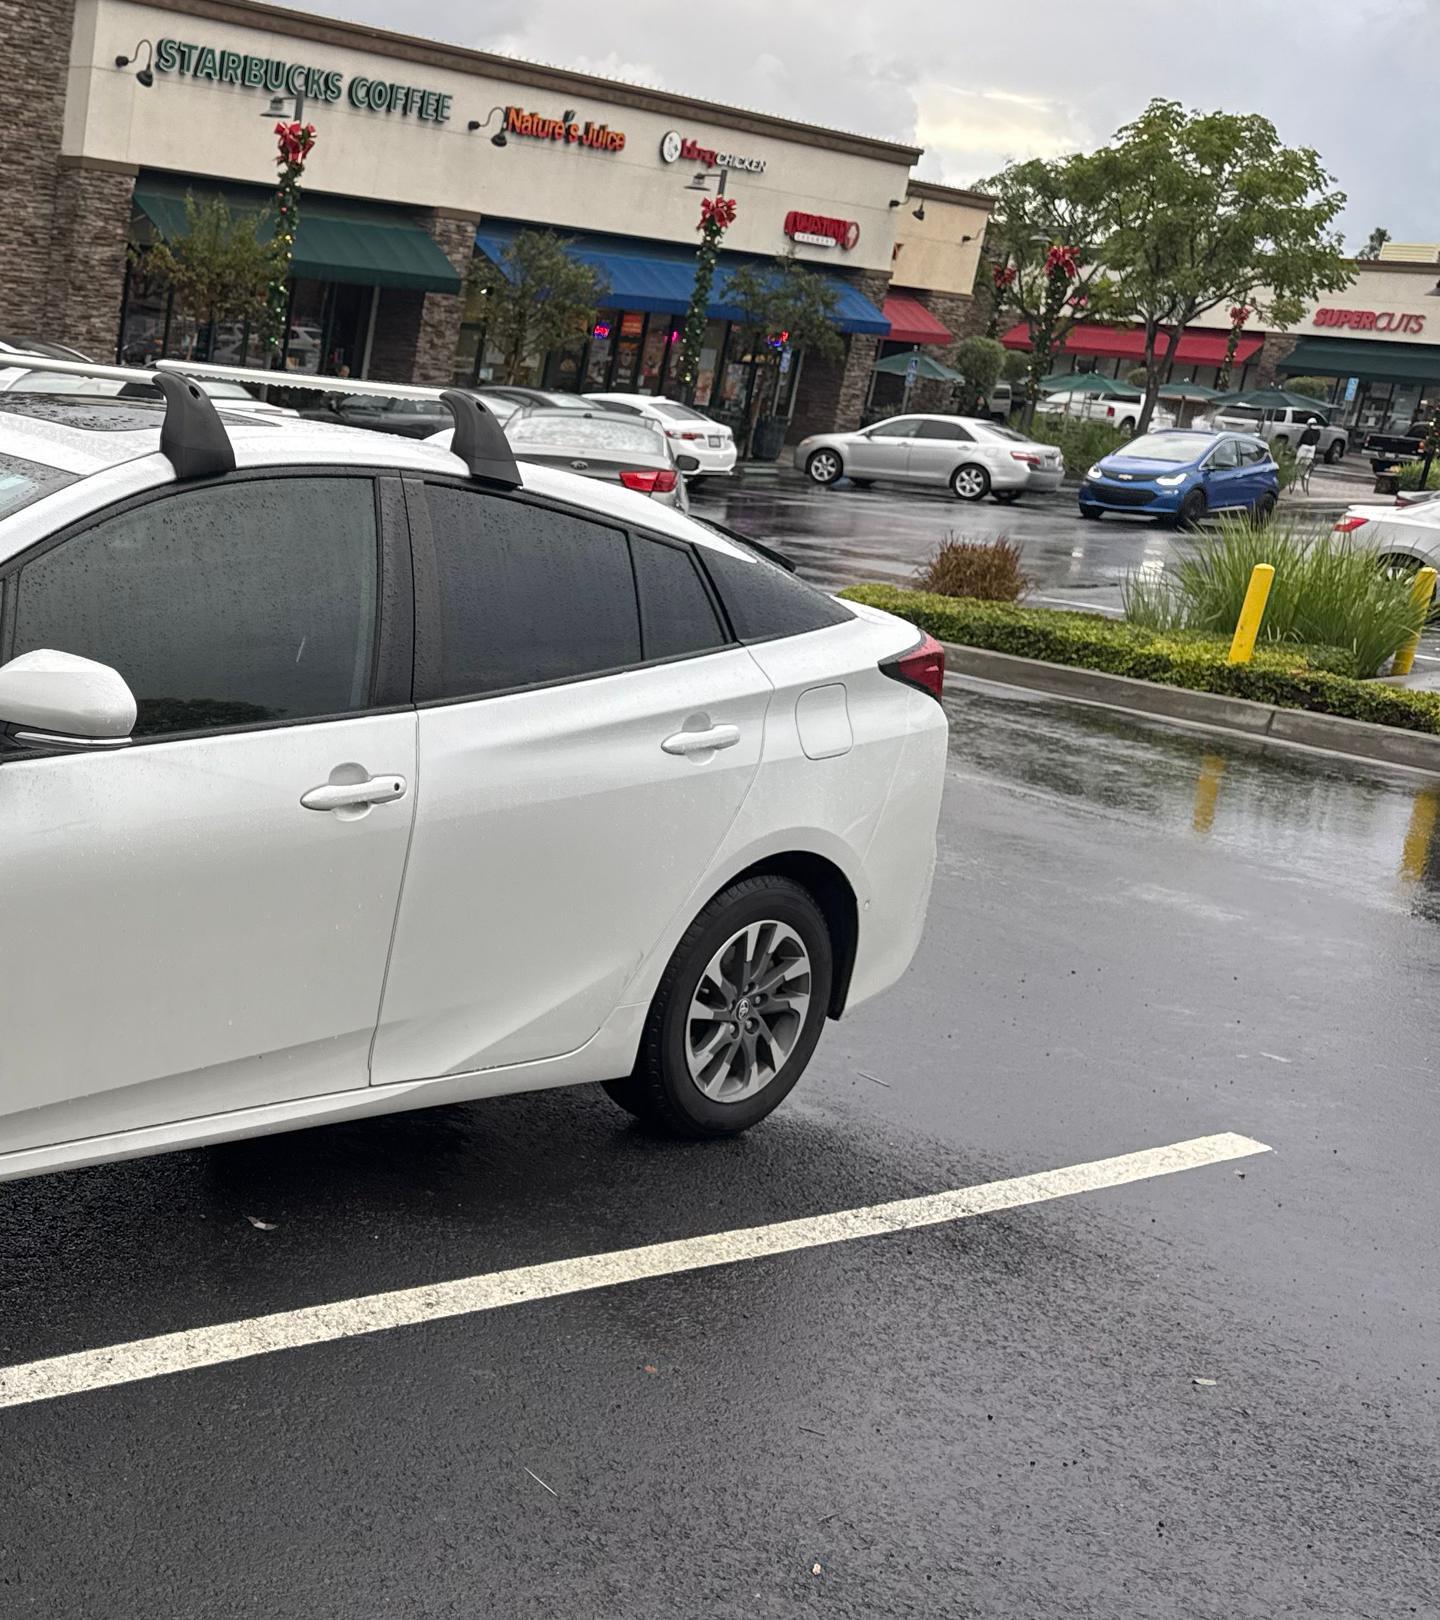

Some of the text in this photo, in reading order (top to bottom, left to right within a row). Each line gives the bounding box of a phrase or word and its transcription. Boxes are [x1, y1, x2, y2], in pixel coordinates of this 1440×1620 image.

[157, 38, 454, 122] STARBUCKS COFFEE
[505, 105, 626, 152] Nature's Juice
[716, 152, 766, 173] CHICKEN
[1313, 308, 1427, 334] SUPERCUTS
